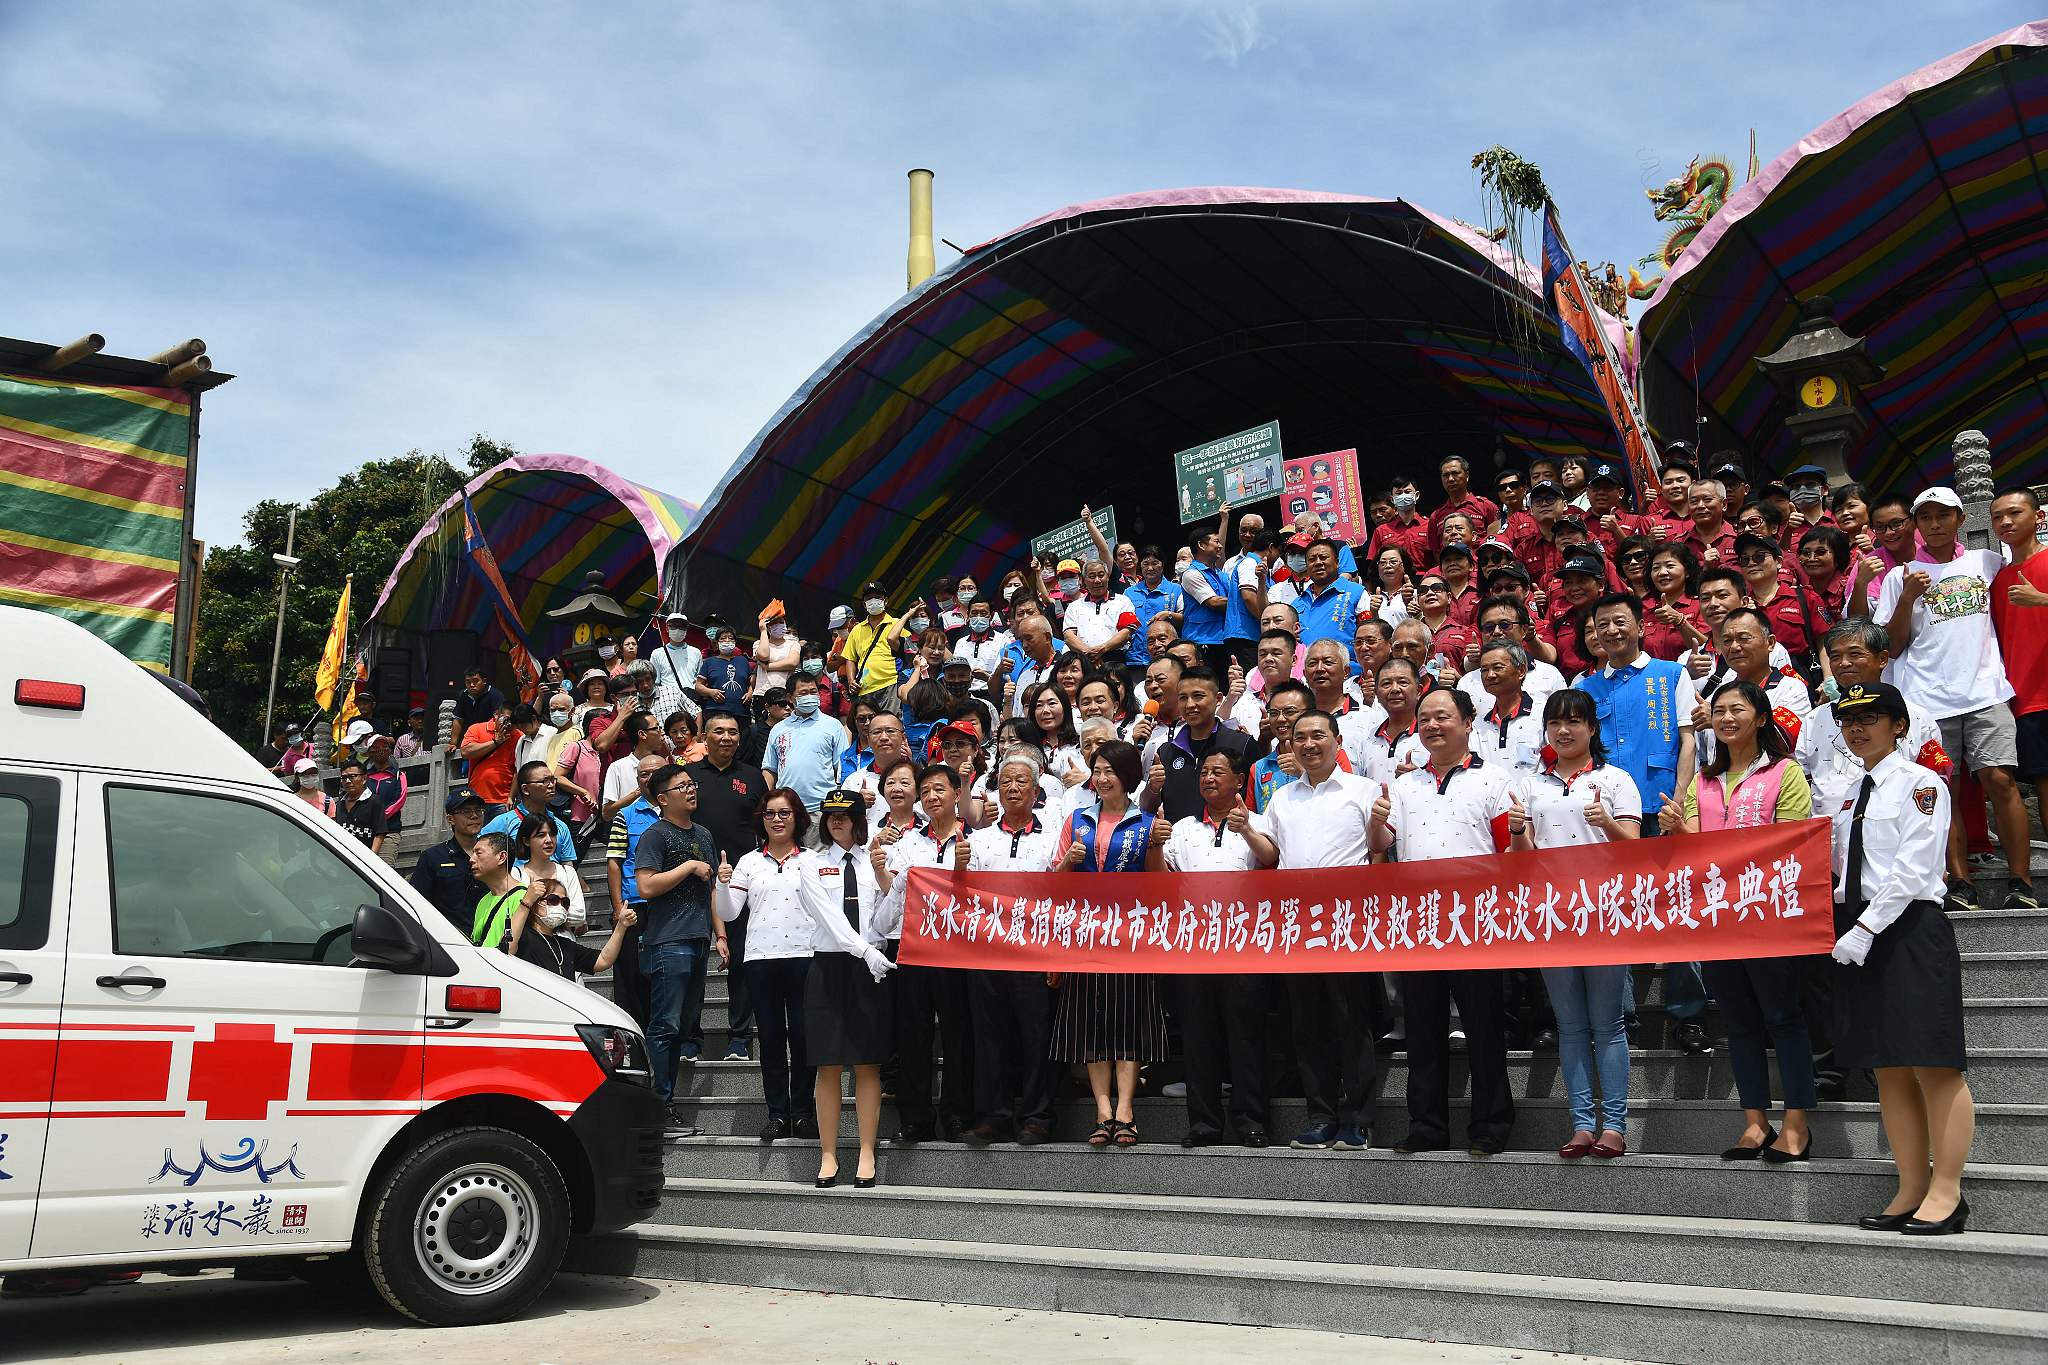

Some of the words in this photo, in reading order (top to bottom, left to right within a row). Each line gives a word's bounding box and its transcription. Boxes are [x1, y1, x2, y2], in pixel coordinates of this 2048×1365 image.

[1181, 427, 1273, 466] 退一步就是最好的保護
[1037, 512, 1108, 552] 退一步就是最好保護
[1645, 677, 1657, 696] 里長
[1735, 787, 1753, 829] 鄭宇
[1751, 781, 1767, 828] 新北市議
[919, 853, 1804, 955] 淡水清水巖捐贈新北市政府消防局第三救災救護大隊淡水分隊救護車典禮
[141, 1203, 160, 1239] 淡水
[164, 1194, 275, 1238] 清水巖
[295, 1227, 310, 1235] 1937
